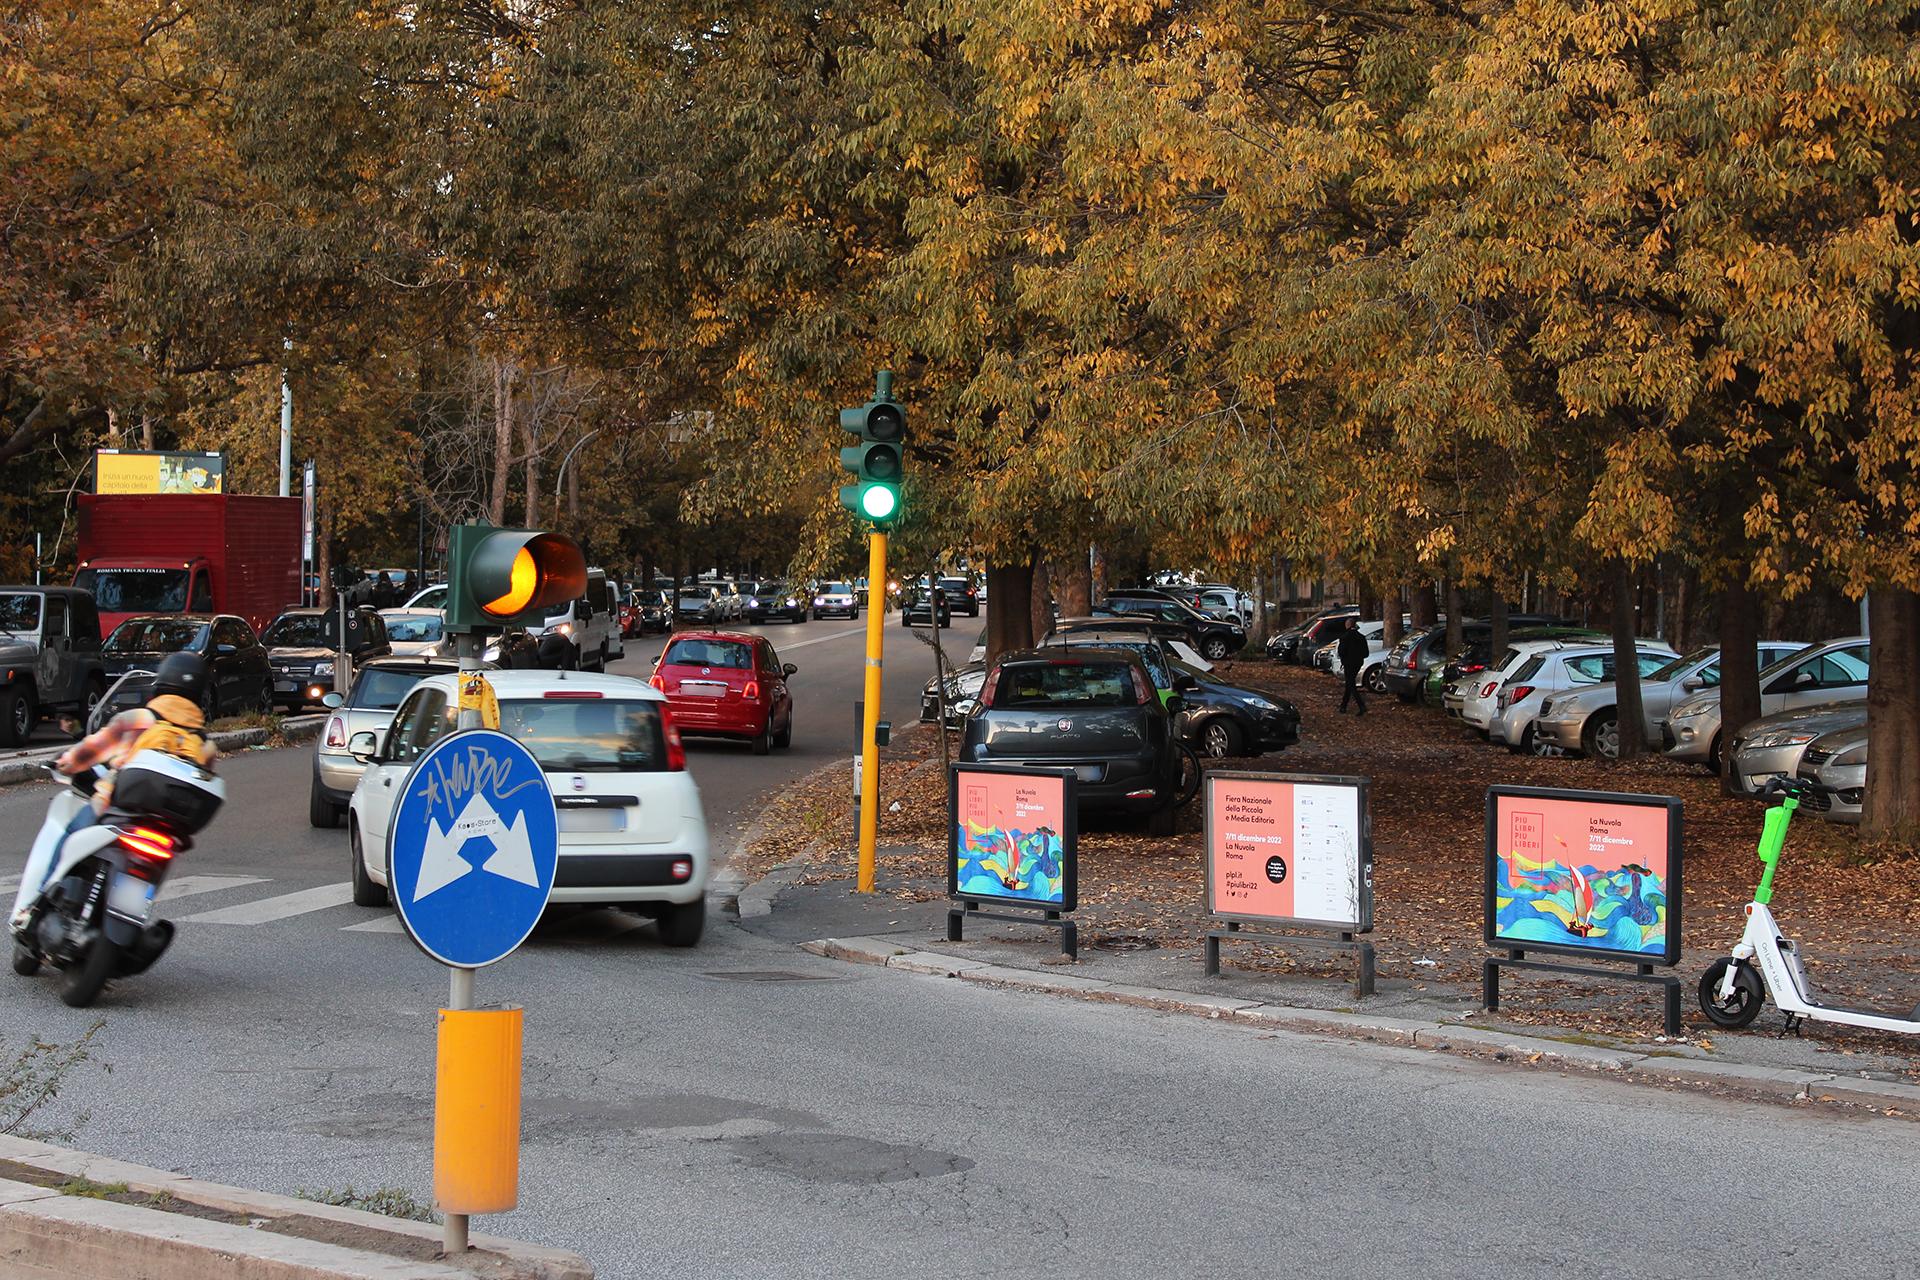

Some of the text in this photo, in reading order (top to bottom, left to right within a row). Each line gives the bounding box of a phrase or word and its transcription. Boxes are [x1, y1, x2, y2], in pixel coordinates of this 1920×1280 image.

[1225, 795, 1273, 804] Fiera Nazionale
[1242, 806, 1263, 814] Piccola
[1251, 816, 1275, 824] Editoria
[1599, 818, 1622, 826] Nuvola
[1590, 826, 1609, 834] Roma
[1237, 834, 1266, 843] dicembre
[1267, 836, 1282, 844] 2022
[1602, 836, 1633, 845] dicembre
[1234, 843, 1256, 851] Nuvola
[1515, 840, 1539, 849] LIBERI
[1225, 852, 1243, 860] Roma
